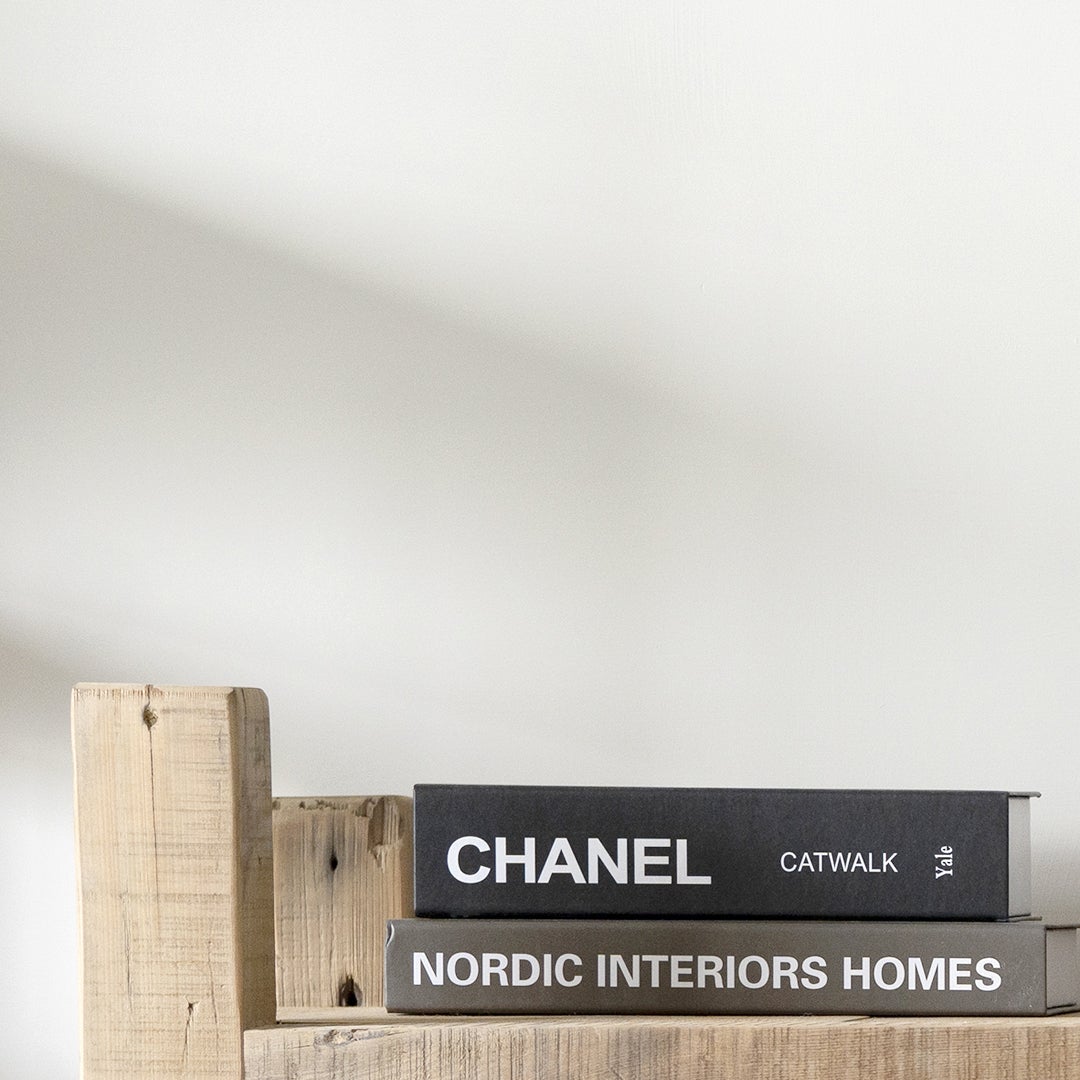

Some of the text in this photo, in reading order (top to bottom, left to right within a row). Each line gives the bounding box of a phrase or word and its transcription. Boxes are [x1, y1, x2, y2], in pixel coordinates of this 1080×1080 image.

[446, 835, 712, 886] CHANEL
[780, 850, 899, 874] CATWALK
[933, 844, 954, 880] Yale
[412, 951, 1002, 992] NORDIC INTERIORS HOMES
